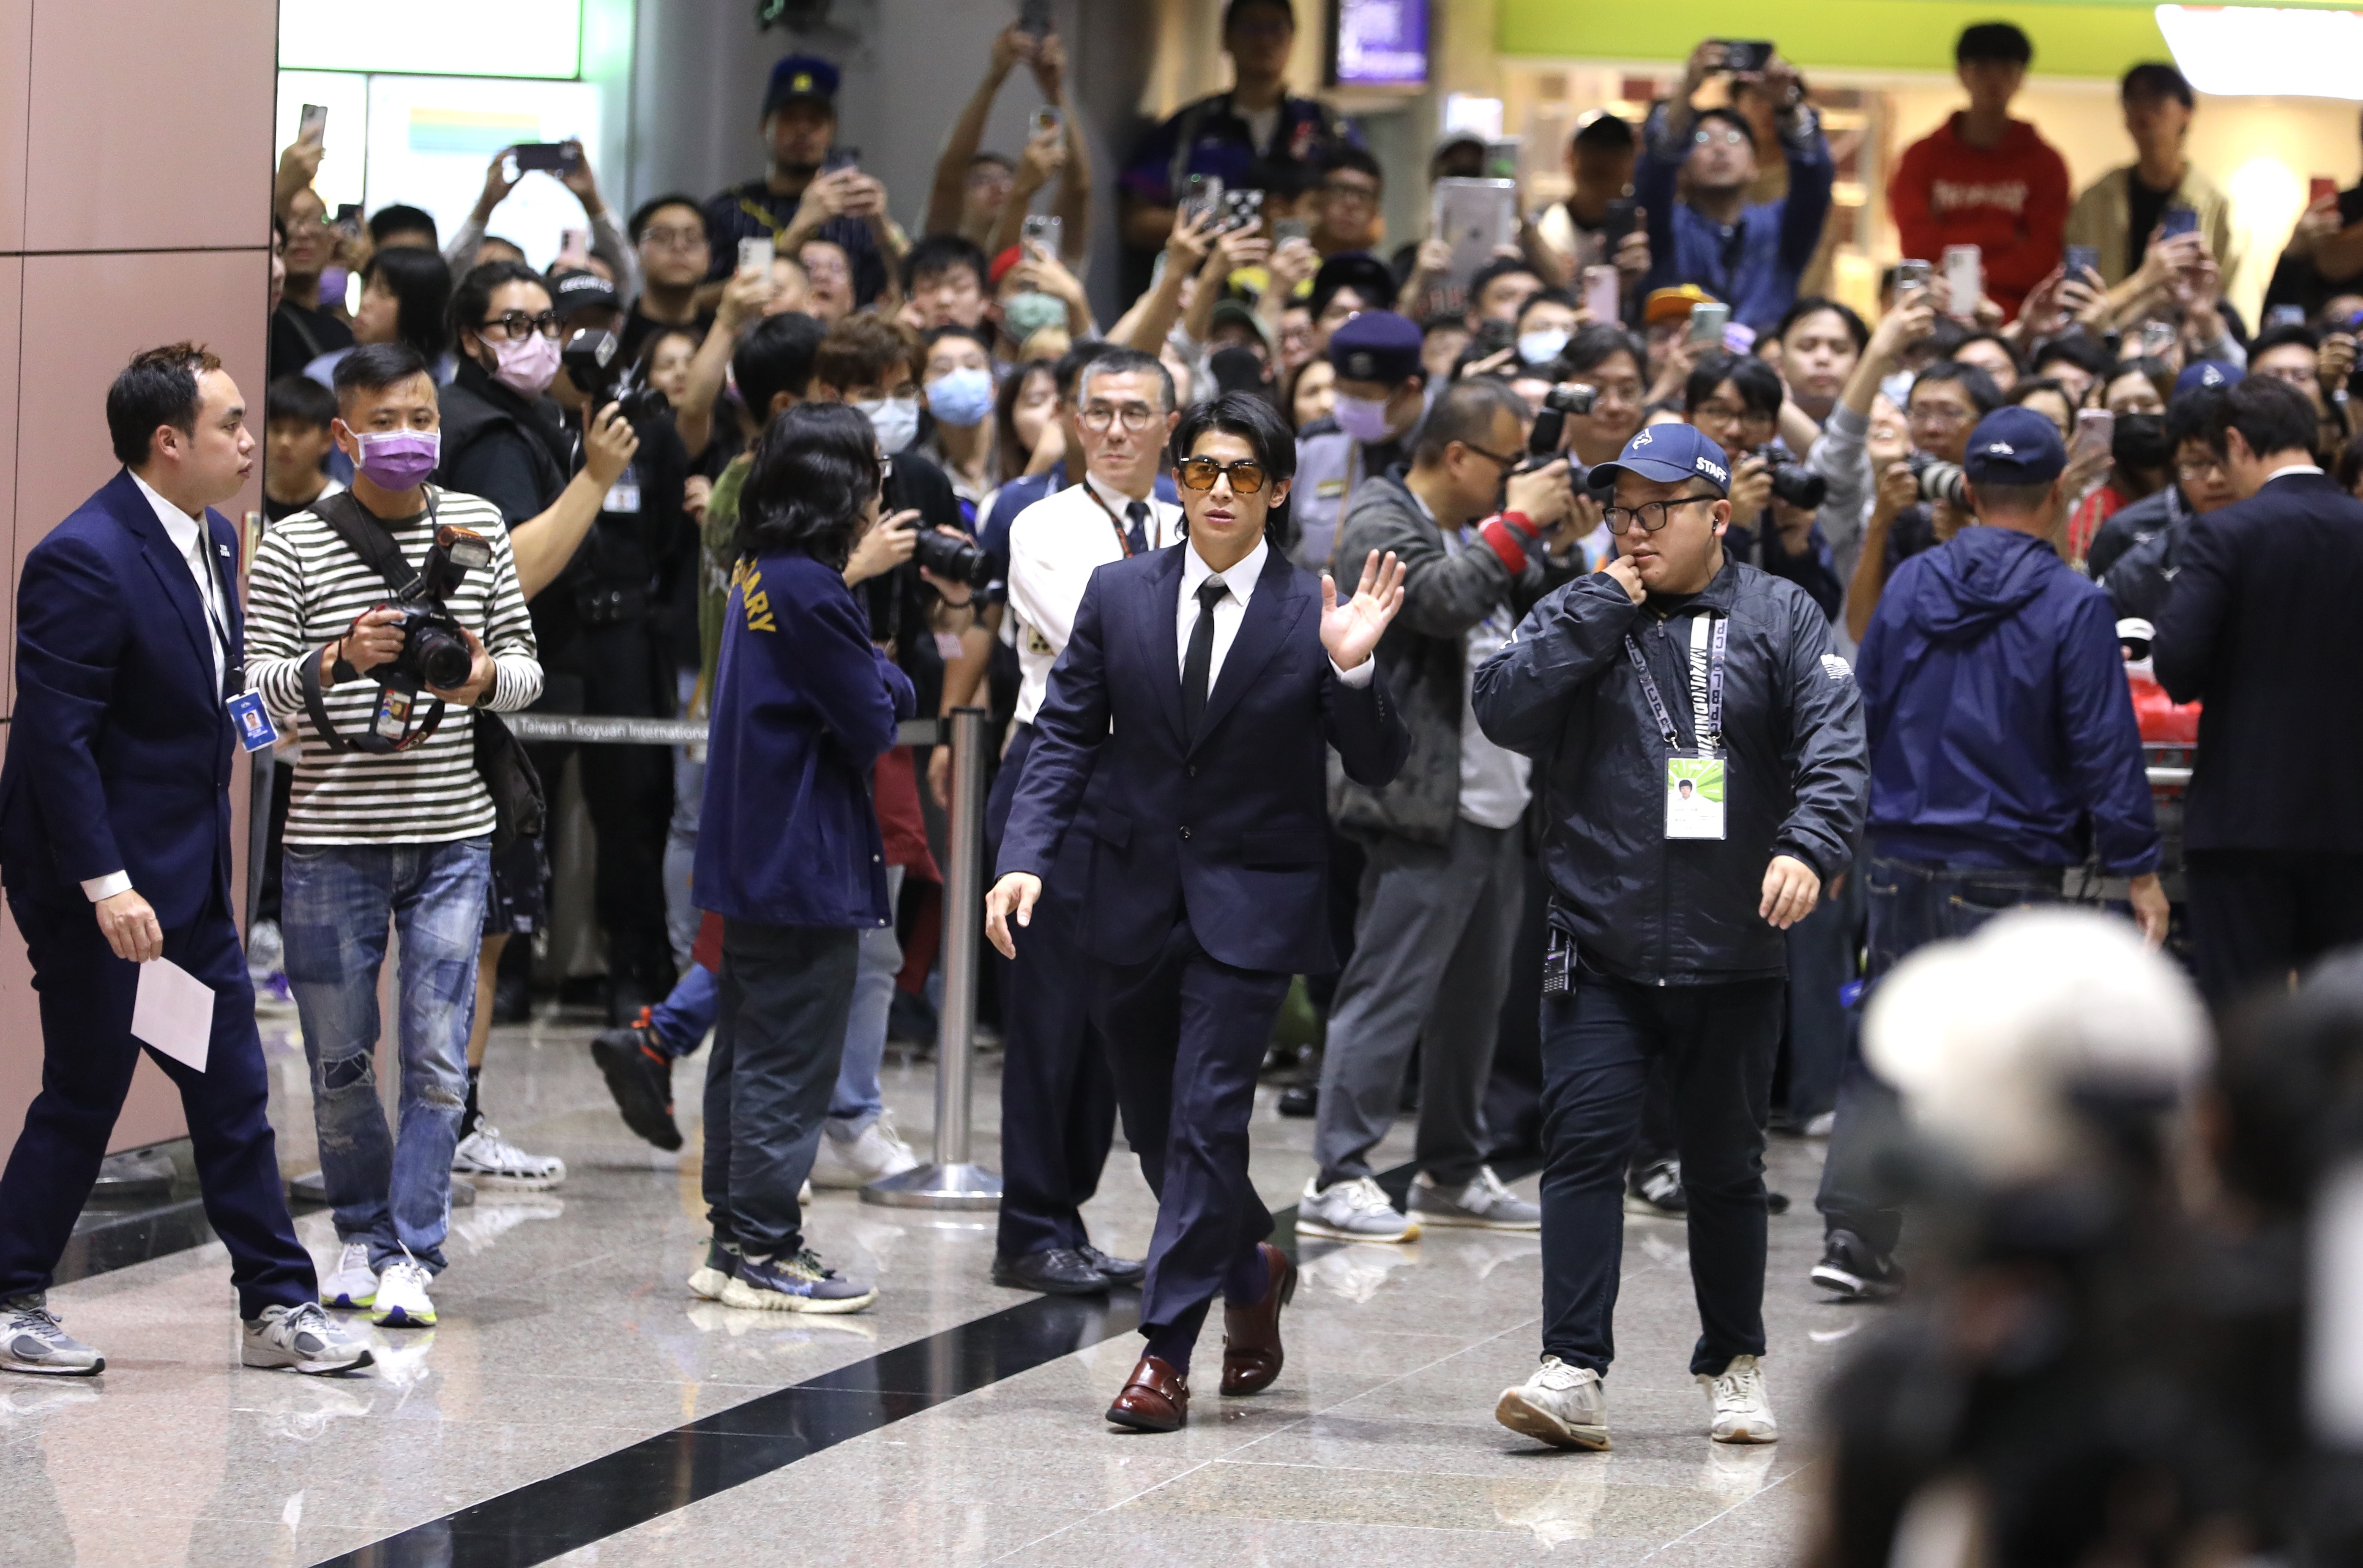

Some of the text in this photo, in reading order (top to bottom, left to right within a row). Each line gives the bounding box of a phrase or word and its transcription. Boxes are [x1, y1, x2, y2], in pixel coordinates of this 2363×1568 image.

[1696, 456, 1727, 483] STAFF
[520, 718, 567, 735] Taiwan
[569, 719, 625, 740] Taoyuan
